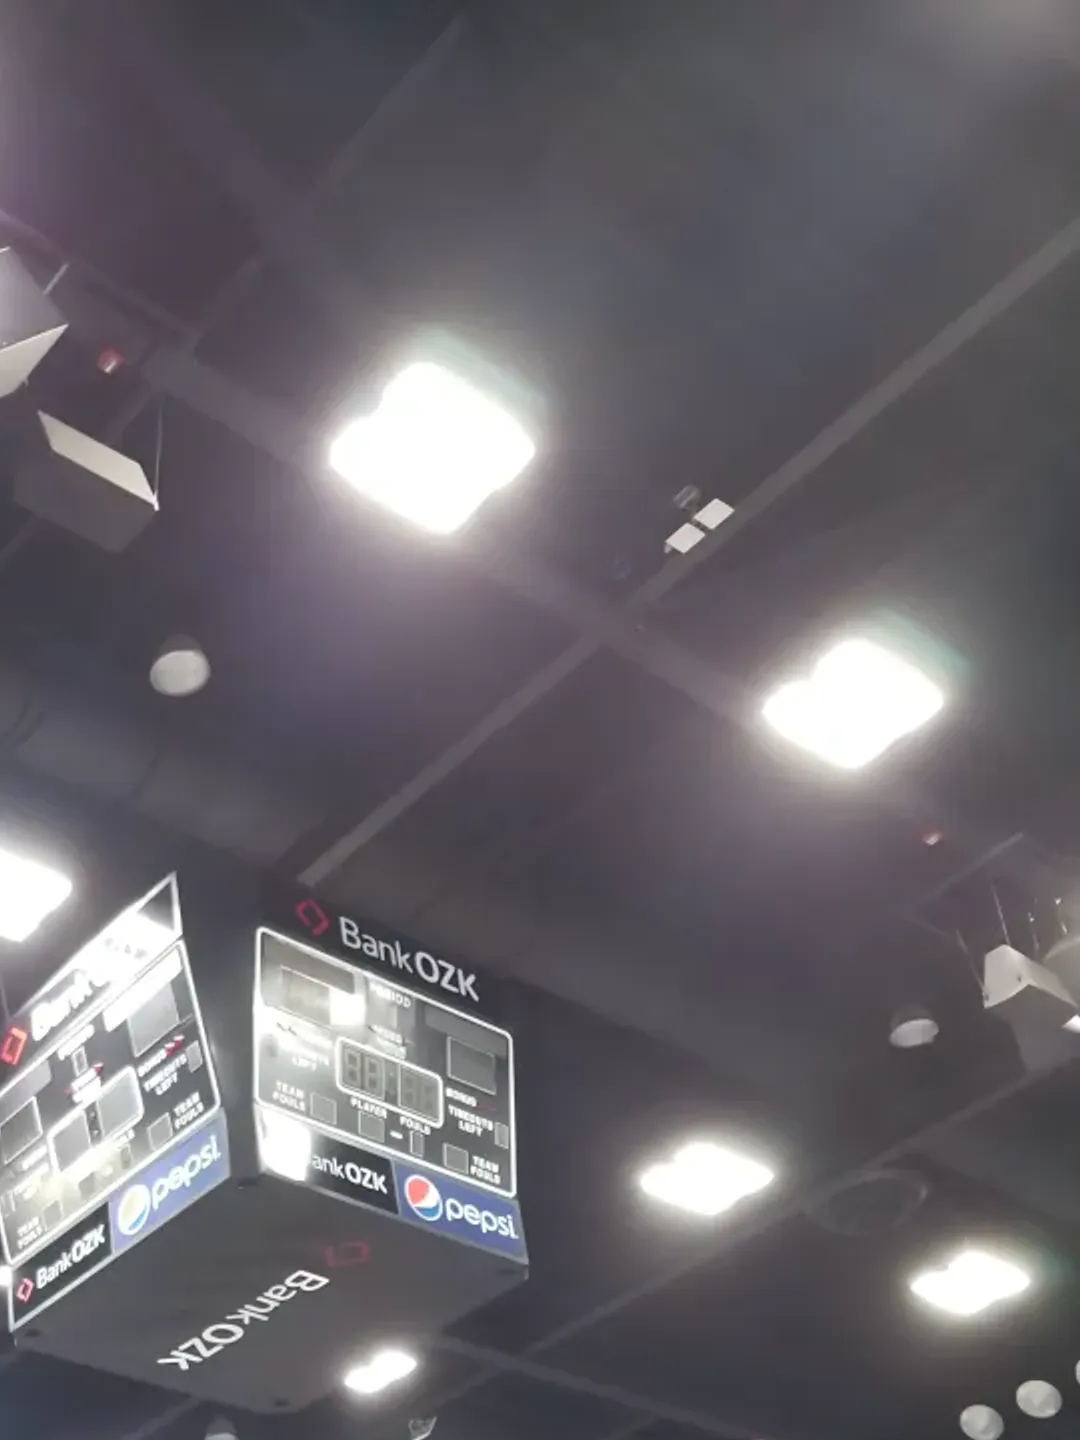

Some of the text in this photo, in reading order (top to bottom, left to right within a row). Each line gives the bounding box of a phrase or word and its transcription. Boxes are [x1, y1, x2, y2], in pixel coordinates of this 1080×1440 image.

[152, 1134, 221, 1212] pepsi
[311, 1153, 388, 1194] ankOZK
[445, 1198, 518, 1239] pepsi
